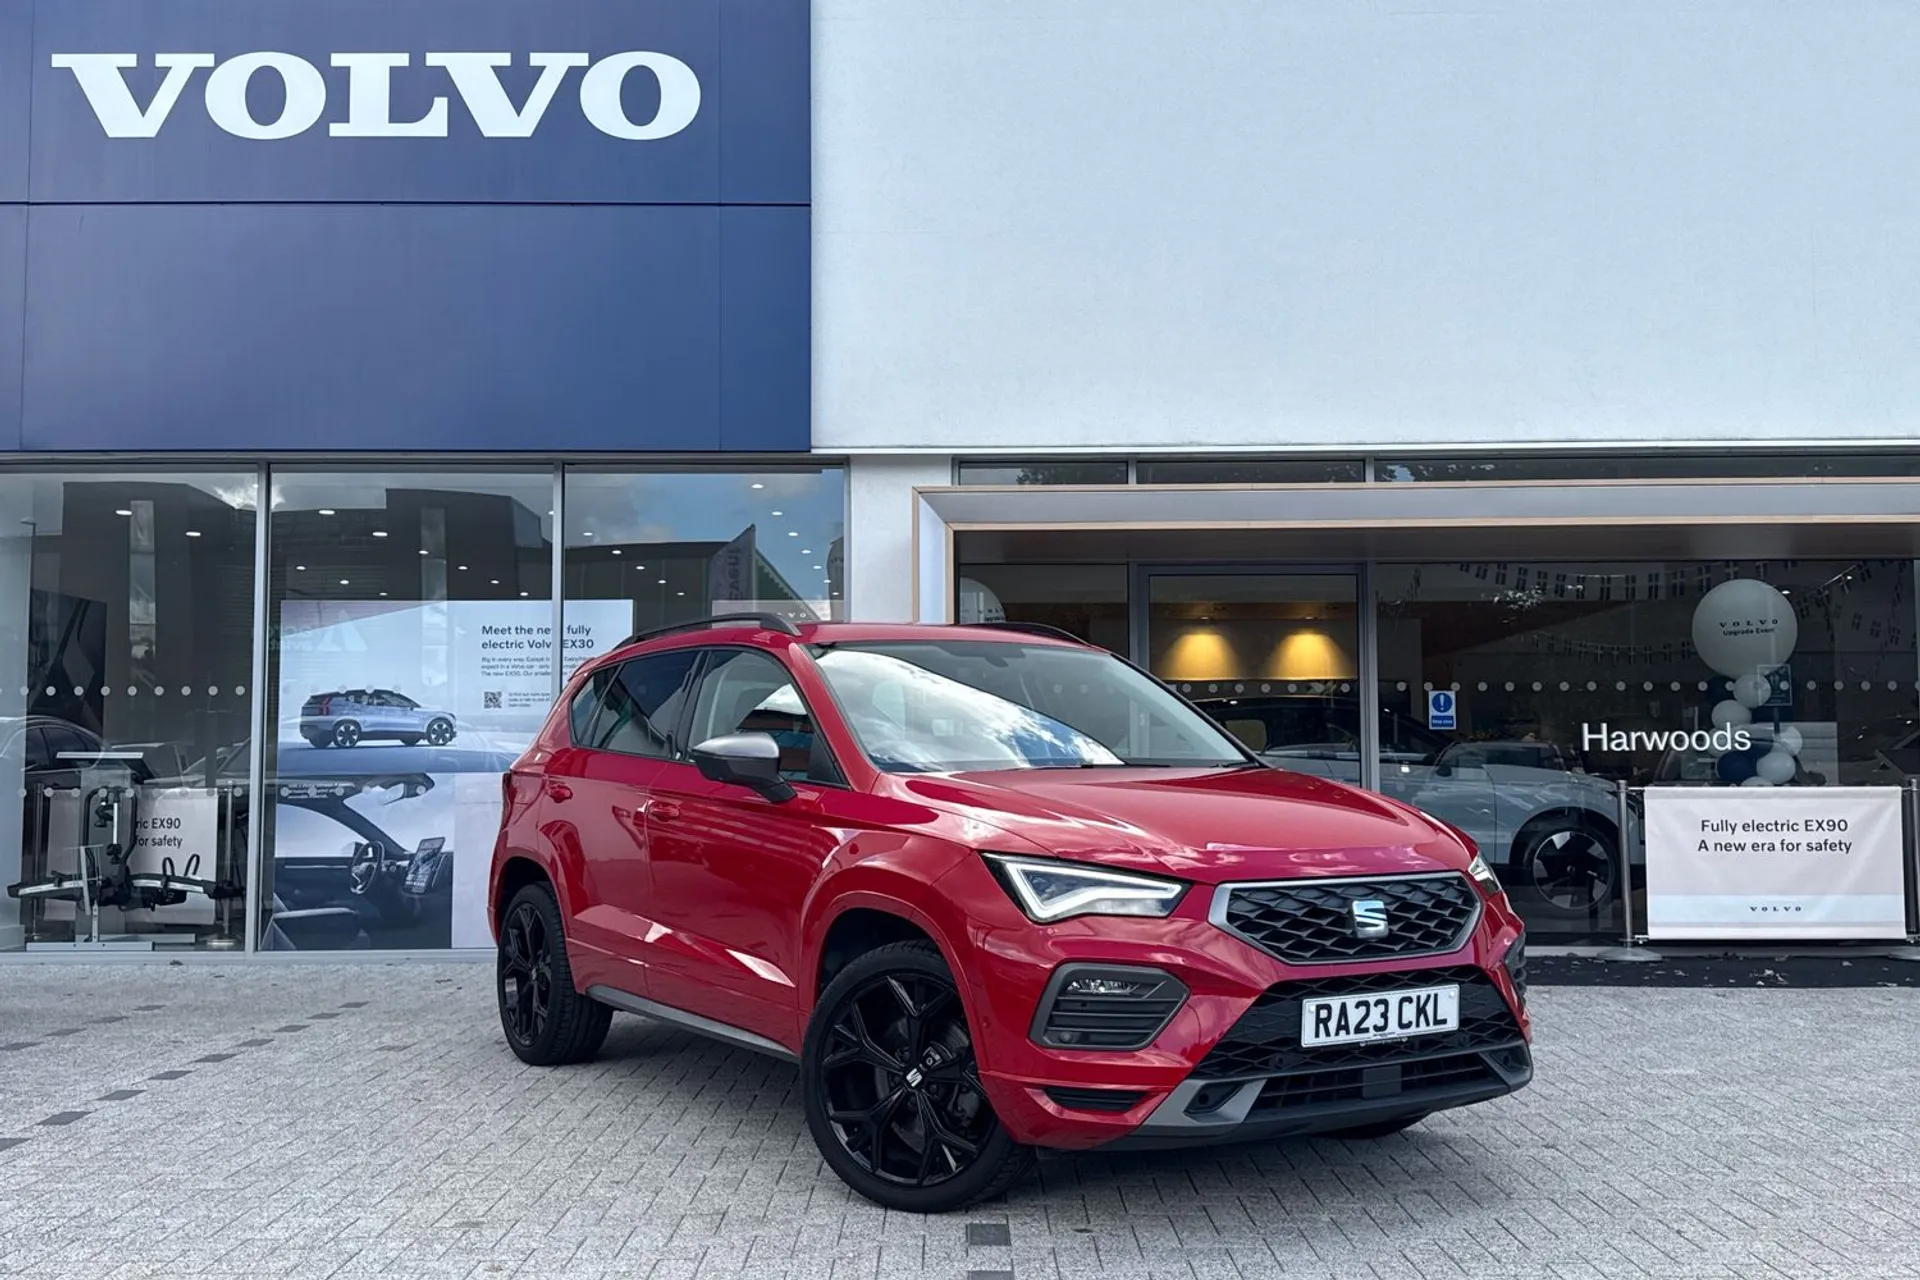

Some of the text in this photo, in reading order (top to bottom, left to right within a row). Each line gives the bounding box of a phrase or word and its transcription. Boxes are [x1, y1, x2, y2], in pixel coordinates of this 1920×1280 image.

[51, 51, 701, 140] VOLVO
[481, 625, 512, 635] Meet
[515, 625, 534, 635] the
[566, 625, 592, 636] fully
[1719, 618, 1778, 628] VOLVO
[481, 638, 594, 649] electric Volv EX30
[1582, 721, 1751, 751] Harwoods
[151, 817, 181, 829] EX90
[1700, 819, 1848, 835] Fully electric EX90
[151, 835, 183, 849] safety
[1698, 838, 1852, 854] A new era for safety
[1314, 993, 1448, 1039] RA23 CKL
